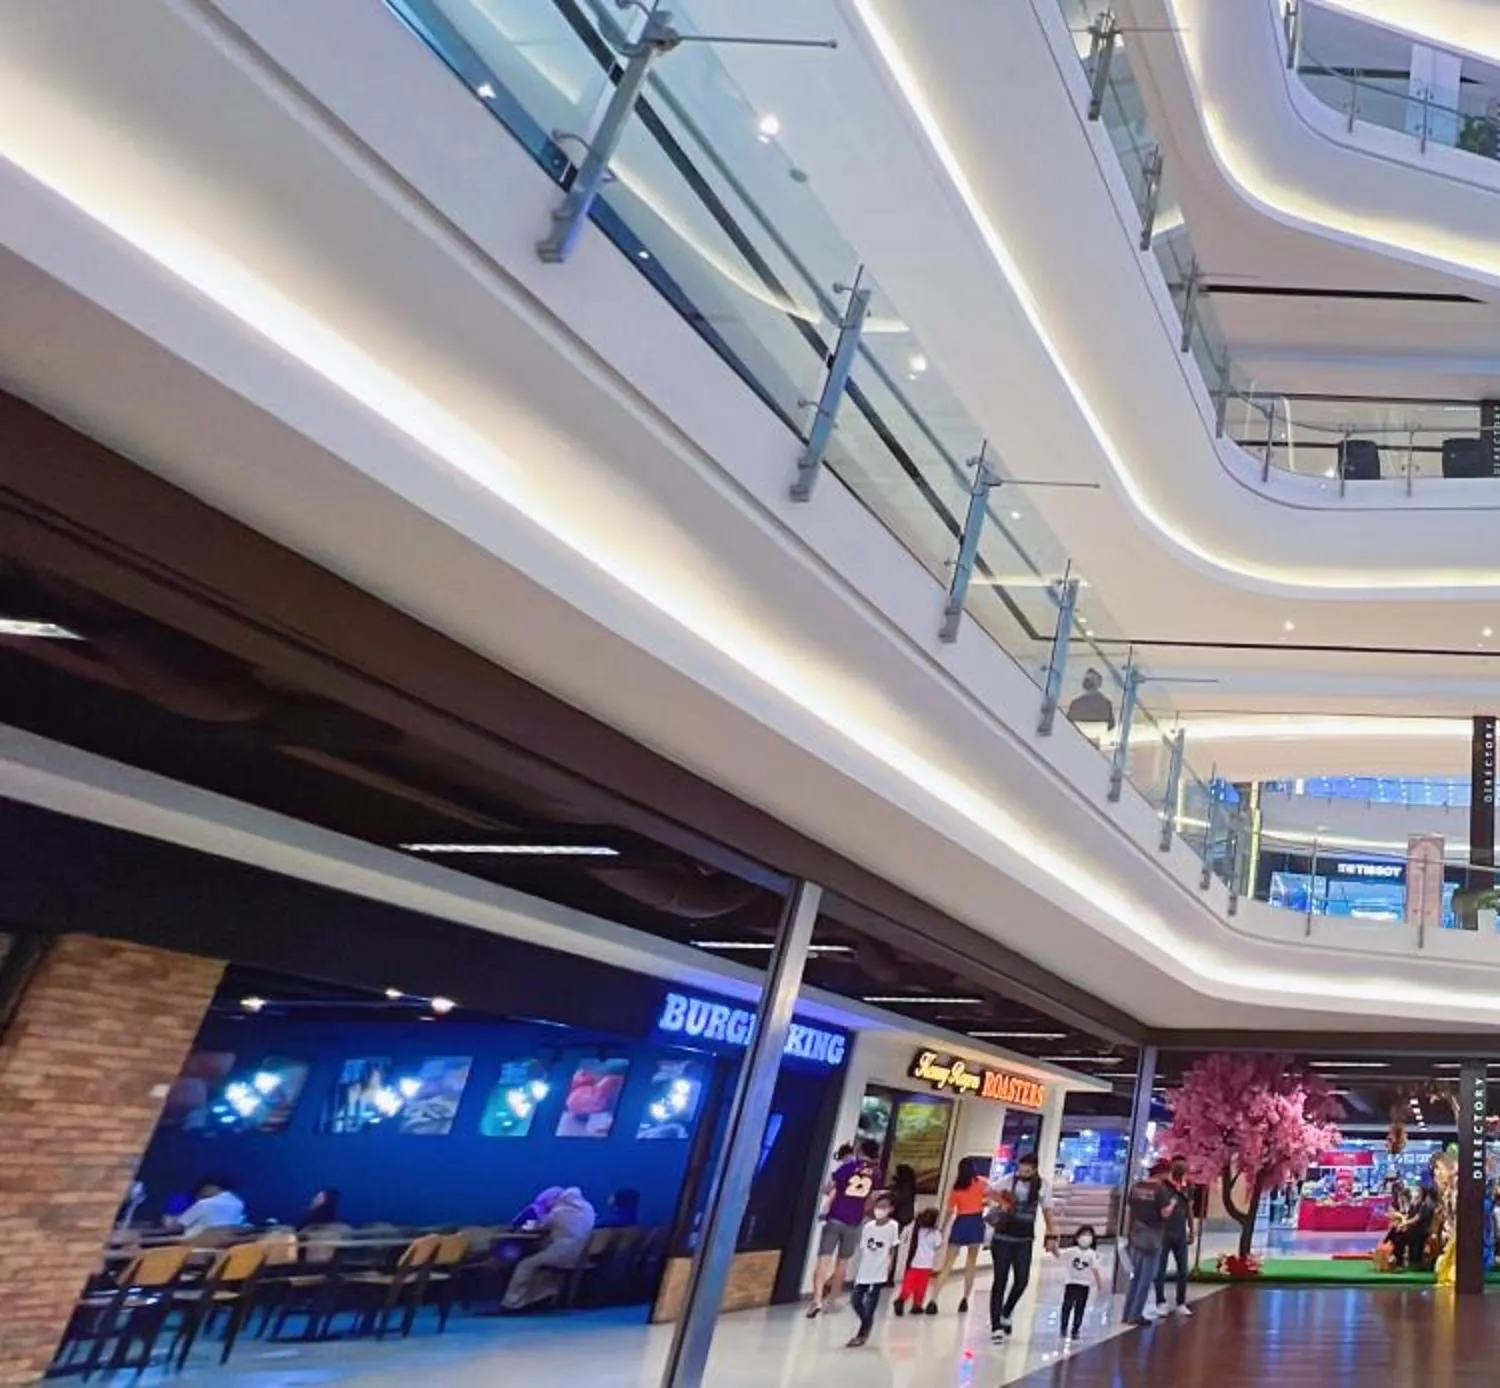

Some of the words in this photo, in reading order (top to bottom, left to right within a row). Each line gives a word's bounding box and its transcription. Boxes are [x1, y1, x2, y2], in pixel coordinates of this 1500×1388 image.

[658, 993, 757, 1047] BURG
[784, 1023, 846, 1065] KING
[981, 1071, 1045, 1107] ROASTERS
[1473, 1076, 1485, 1179] DIRECTORY
[845, 1174, 873, 1197] 23
